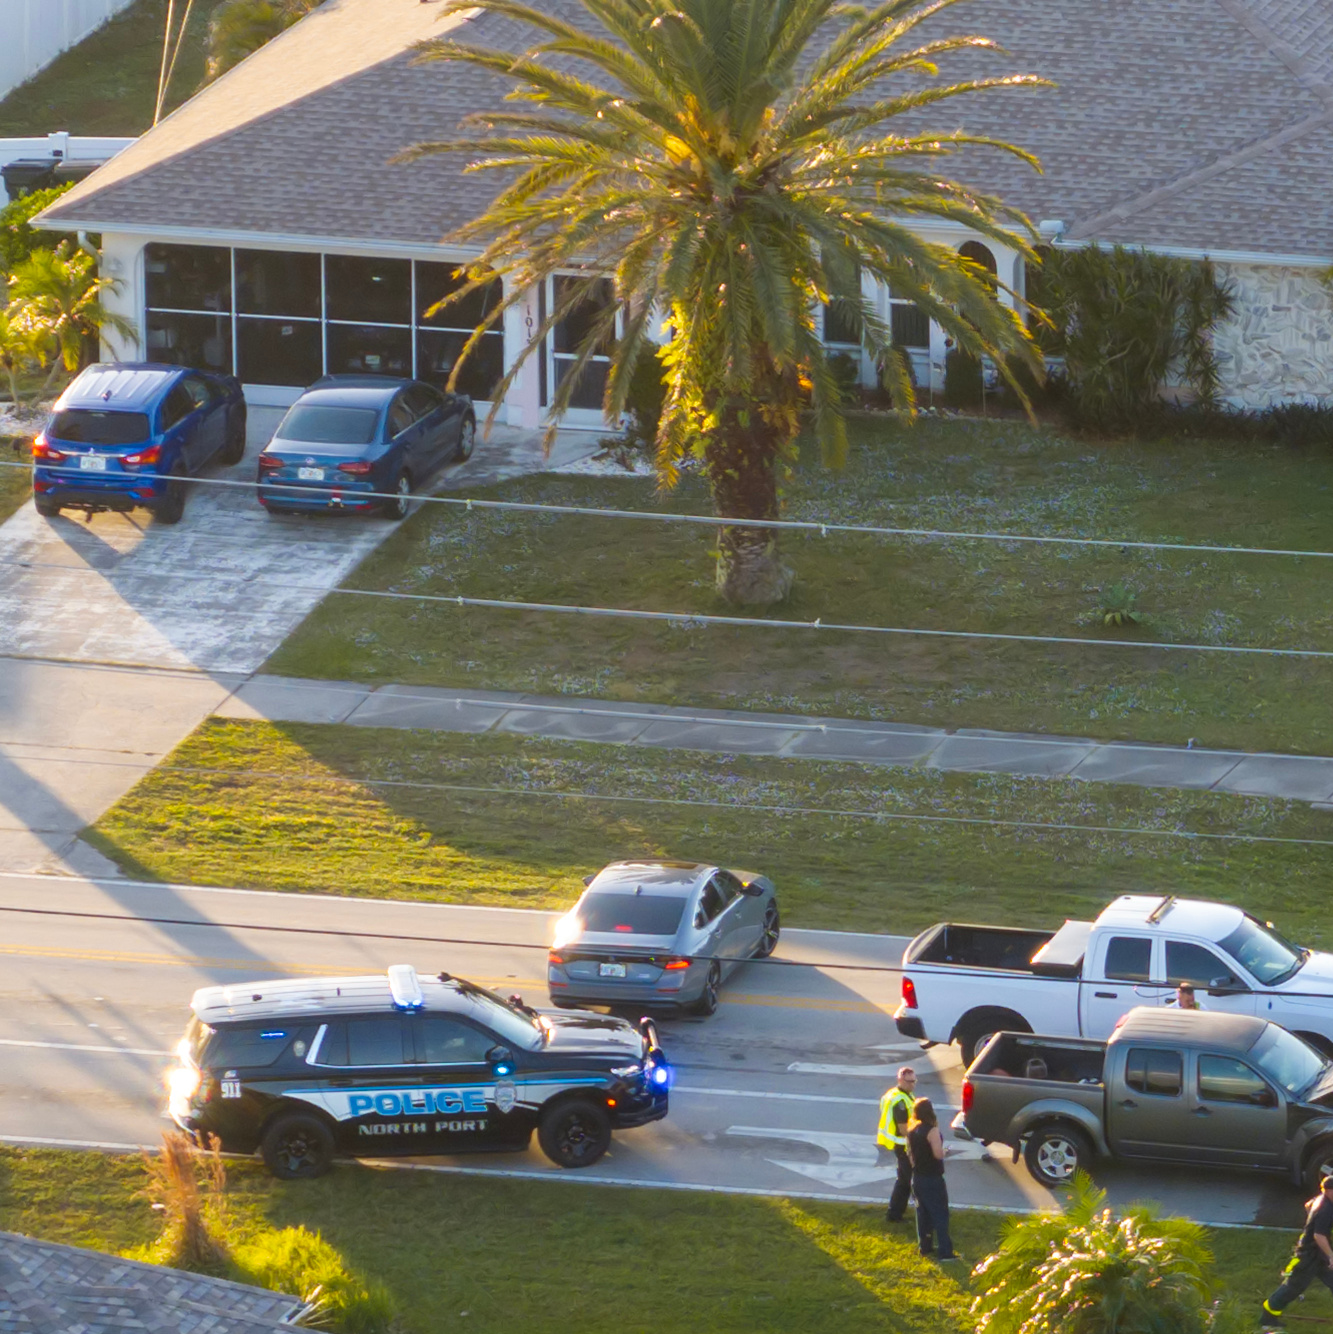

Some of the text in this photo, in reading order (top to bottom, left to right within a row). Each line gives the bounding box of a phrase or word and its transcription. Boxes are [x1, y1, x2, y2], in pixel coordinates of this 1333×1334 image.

[221, 1081, 241, 1098] 911
[349, 1089, 488, 1117] POLICE
[358, 1119, 489, 1135] NORTH PORT
